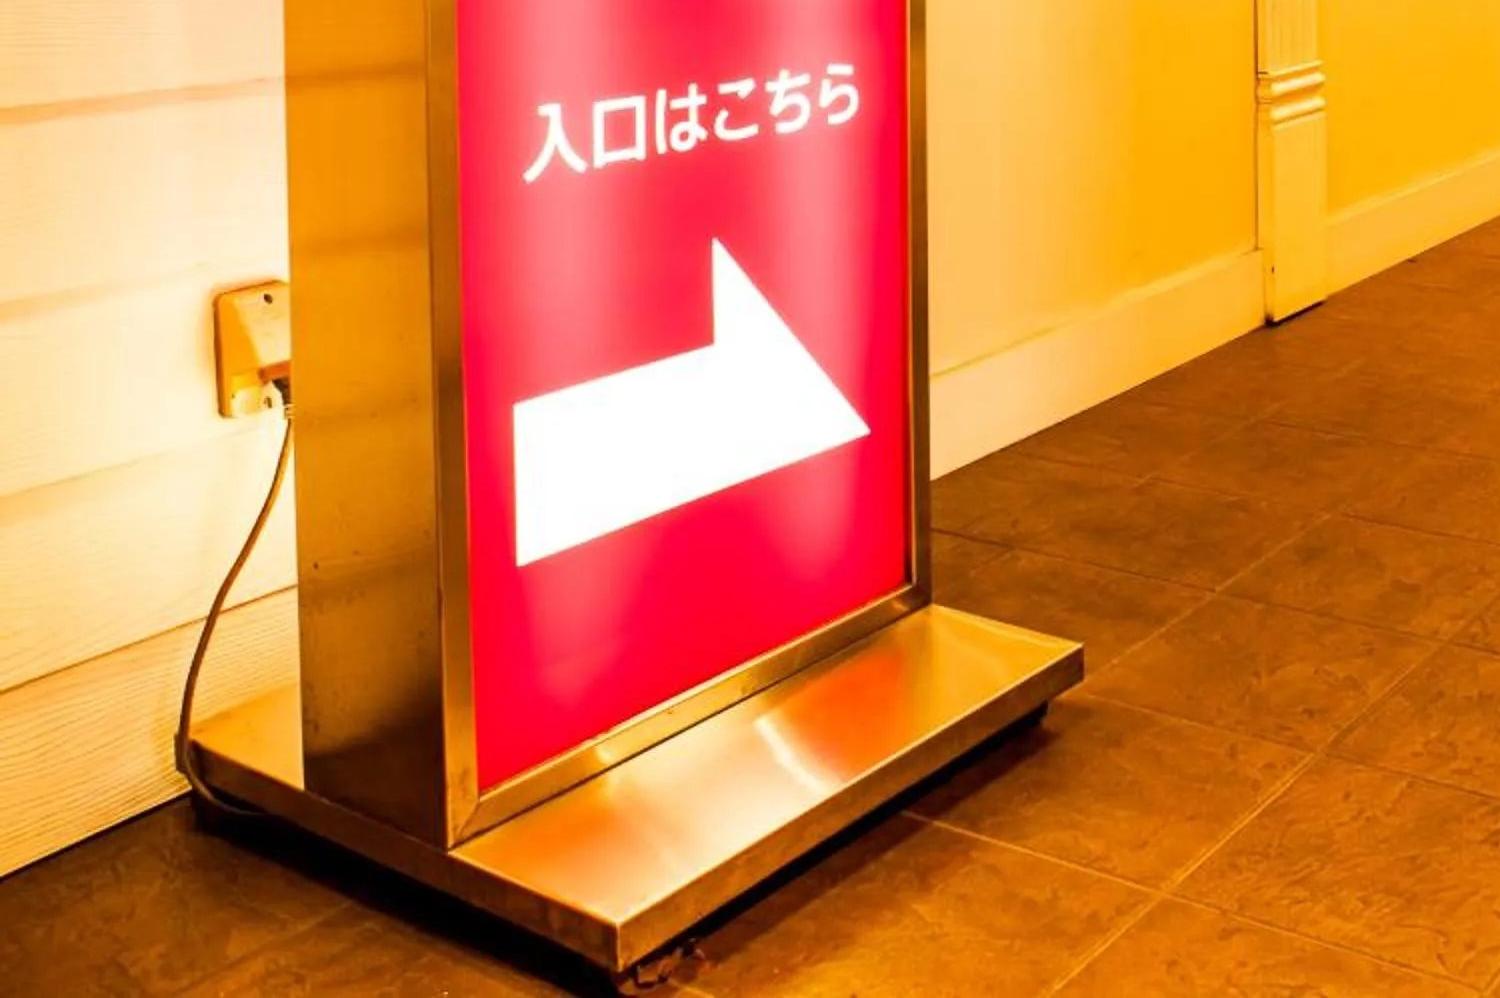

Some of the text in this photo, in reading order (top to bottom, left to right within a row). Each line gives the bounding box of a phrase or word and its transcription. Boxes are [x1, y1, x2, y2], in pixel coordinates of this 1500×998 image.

[522, 62, 861, 183] 入口はこちら
